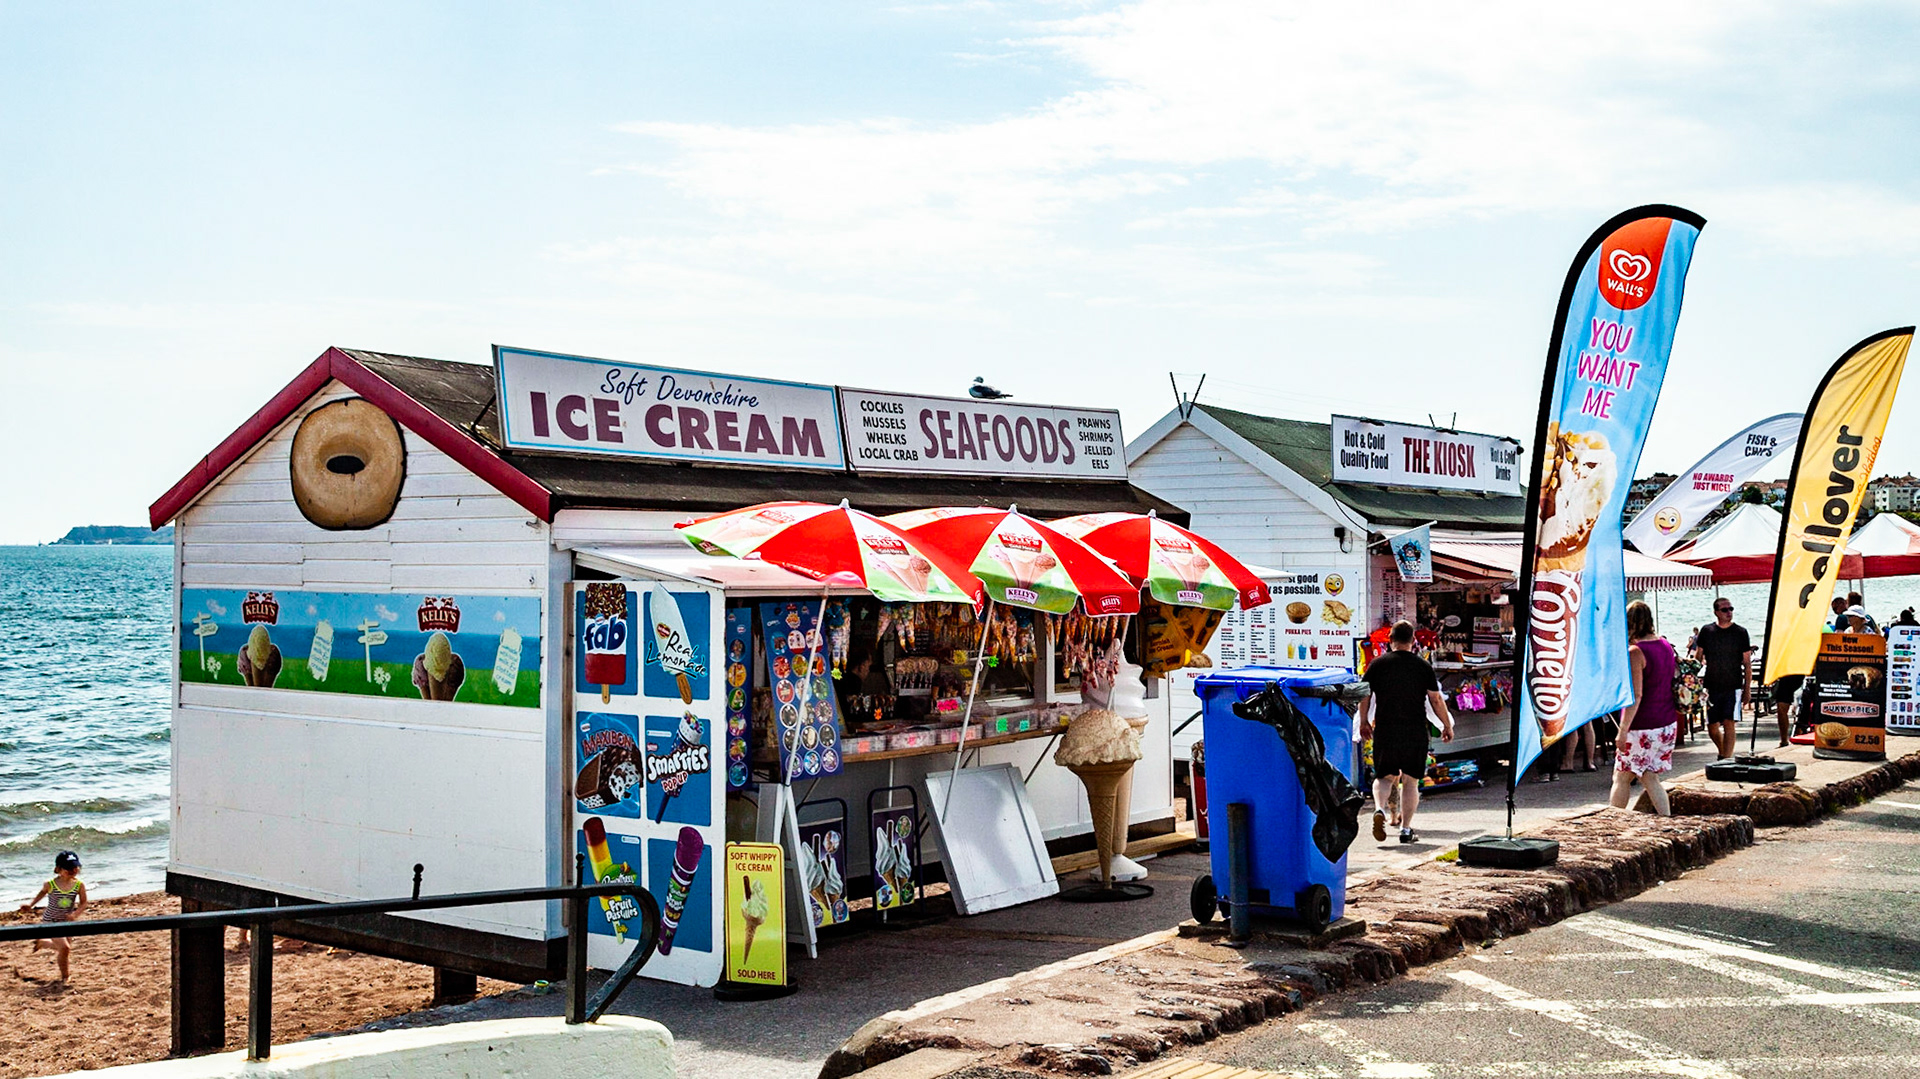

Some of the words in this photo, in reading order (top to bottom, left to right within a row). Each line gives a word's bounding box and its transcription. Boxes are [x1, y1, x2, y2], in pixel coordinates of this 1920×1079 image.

[1607, 278, 1645, 298] WALL'S
[1591, 318, 1633, 353] YOU
[1578, 352, 1640, 390] WANT
[600, 368, 649, 405] Soft
[656, 375, 760, 409] Devonshire
[860, 400, 904, 414] COCKLES
[1581, 387, 1615, 419] ME
[530, 391, 625, 444] ICE
[645, 403, 826, 458] CREAM
[862, 416, 907, 430] MUSSELS
[1077, 417, 1111, 430] PRAWNS
[866, 431, 907, 445] WHELKS
[919, 408, 1076, 465] SEAFOODS
[1079, 431, 1114, 443] SHRIMPS
[1344, 430, 1359, 448] Hot
[1360, 435, 1366, 448] &
[1367, 432, 1385, 450] Cold
[1746, 434, 1769, 446] FISH
[1770, 437, 1778, 447] &
[858, 447, 892, 460] LOCAL
[893, 448, 919, 461] CRAB
[1084, 445, 1113, 456] JELLIED
[1403, 437, 1431, 475] THE
[1434, 440, 1476, 478] KIOSK
[1092, 459, 1110, 470] EELS
[1340, 449, 1369, 470] Quality
[1371, 452, 1389, 470] Food
[1693, 473, 1702, 481] NO
[1703, 473, 1734, 482] AWARDS
[1692, 482, 1709, 491] JUST
[1711, 482, 1731, 492] NICE!
[1297, 573, 1318, 585] good
[1008, 590, 1035, 599] KELLY'S
[1179, 592, 1202, 600] KELLY'S
[1273, 586, 1283, 594] as
[1284, 584, 1322, 596] possible.
[1101, 598, 1121, 607] KELLY'S
[245, 604, 276, 617] KELLY'S
[422, 610, 457, 624] KELLY'S
[584, 615, 627, 651] fab
[1842, 636, 1858, 644] New
[665, 631, 699, 659] Real
[1530, 570, 1582, 722] Cornetto
[1827, 644, 1843, 652] This
[646, 642, 707, 676] Lemonade
[582, 730, 635, 758] MAXIBON
[1855, 734, 1880, 745] £2.50
[662, 778, 677, 791] POP
[677, 771, 688, 786] UP
[730, 852, 748, 861] SOFT
[749, 852, 777, 861] WHIPPY
[735, 863, 747, 871] ICE
[747, 863, 773, 872] CREAM
[608, 898, 633, 912] Fruit
[605, 907, 638, 923] Pastilles
[737, 969, 757, 979] SOLD
[757, 970, 776, 981] HERE
